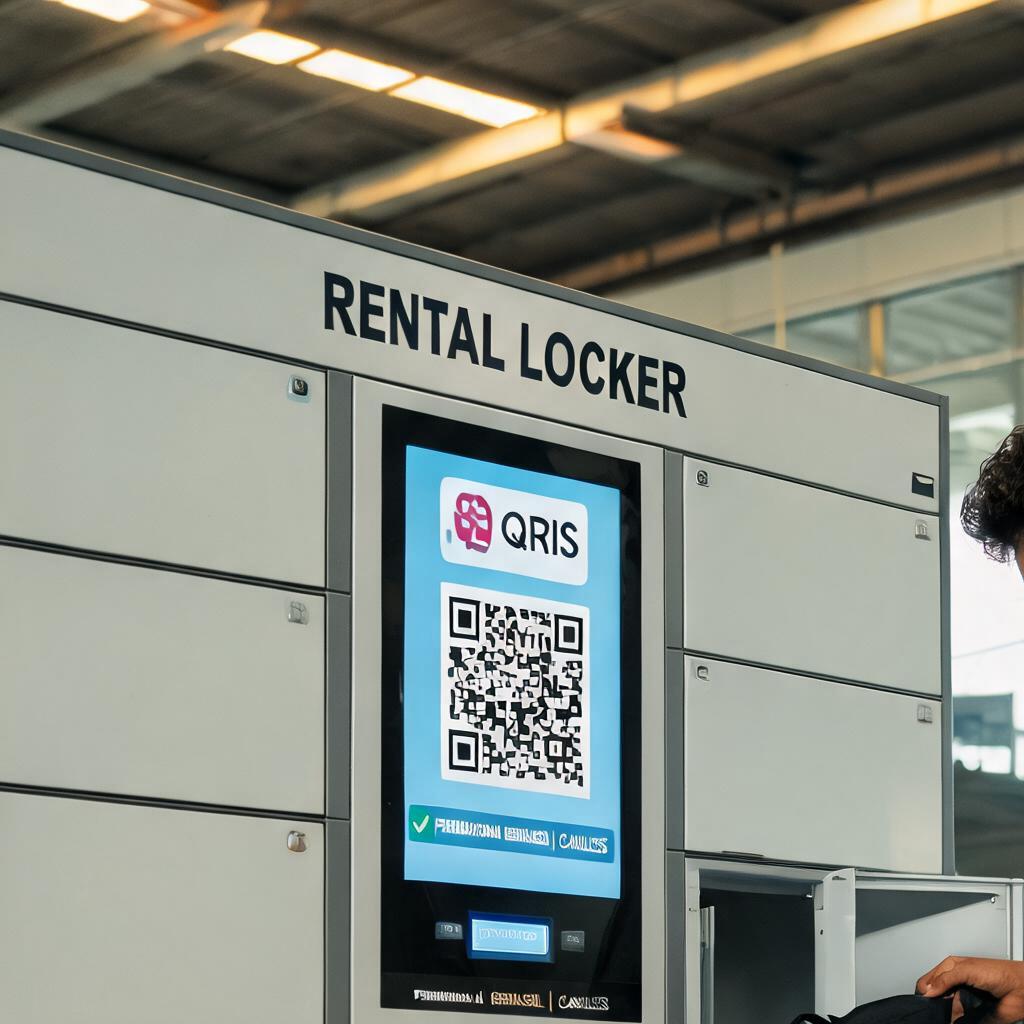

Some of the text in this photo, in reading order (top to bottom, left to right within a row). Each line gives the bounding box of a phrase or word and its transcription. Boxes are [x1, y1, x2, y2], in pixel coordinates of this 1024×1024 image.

[323, 271, 688, 419] RENTAL LOCKER
[501, 511, 579, 559] QRIS
